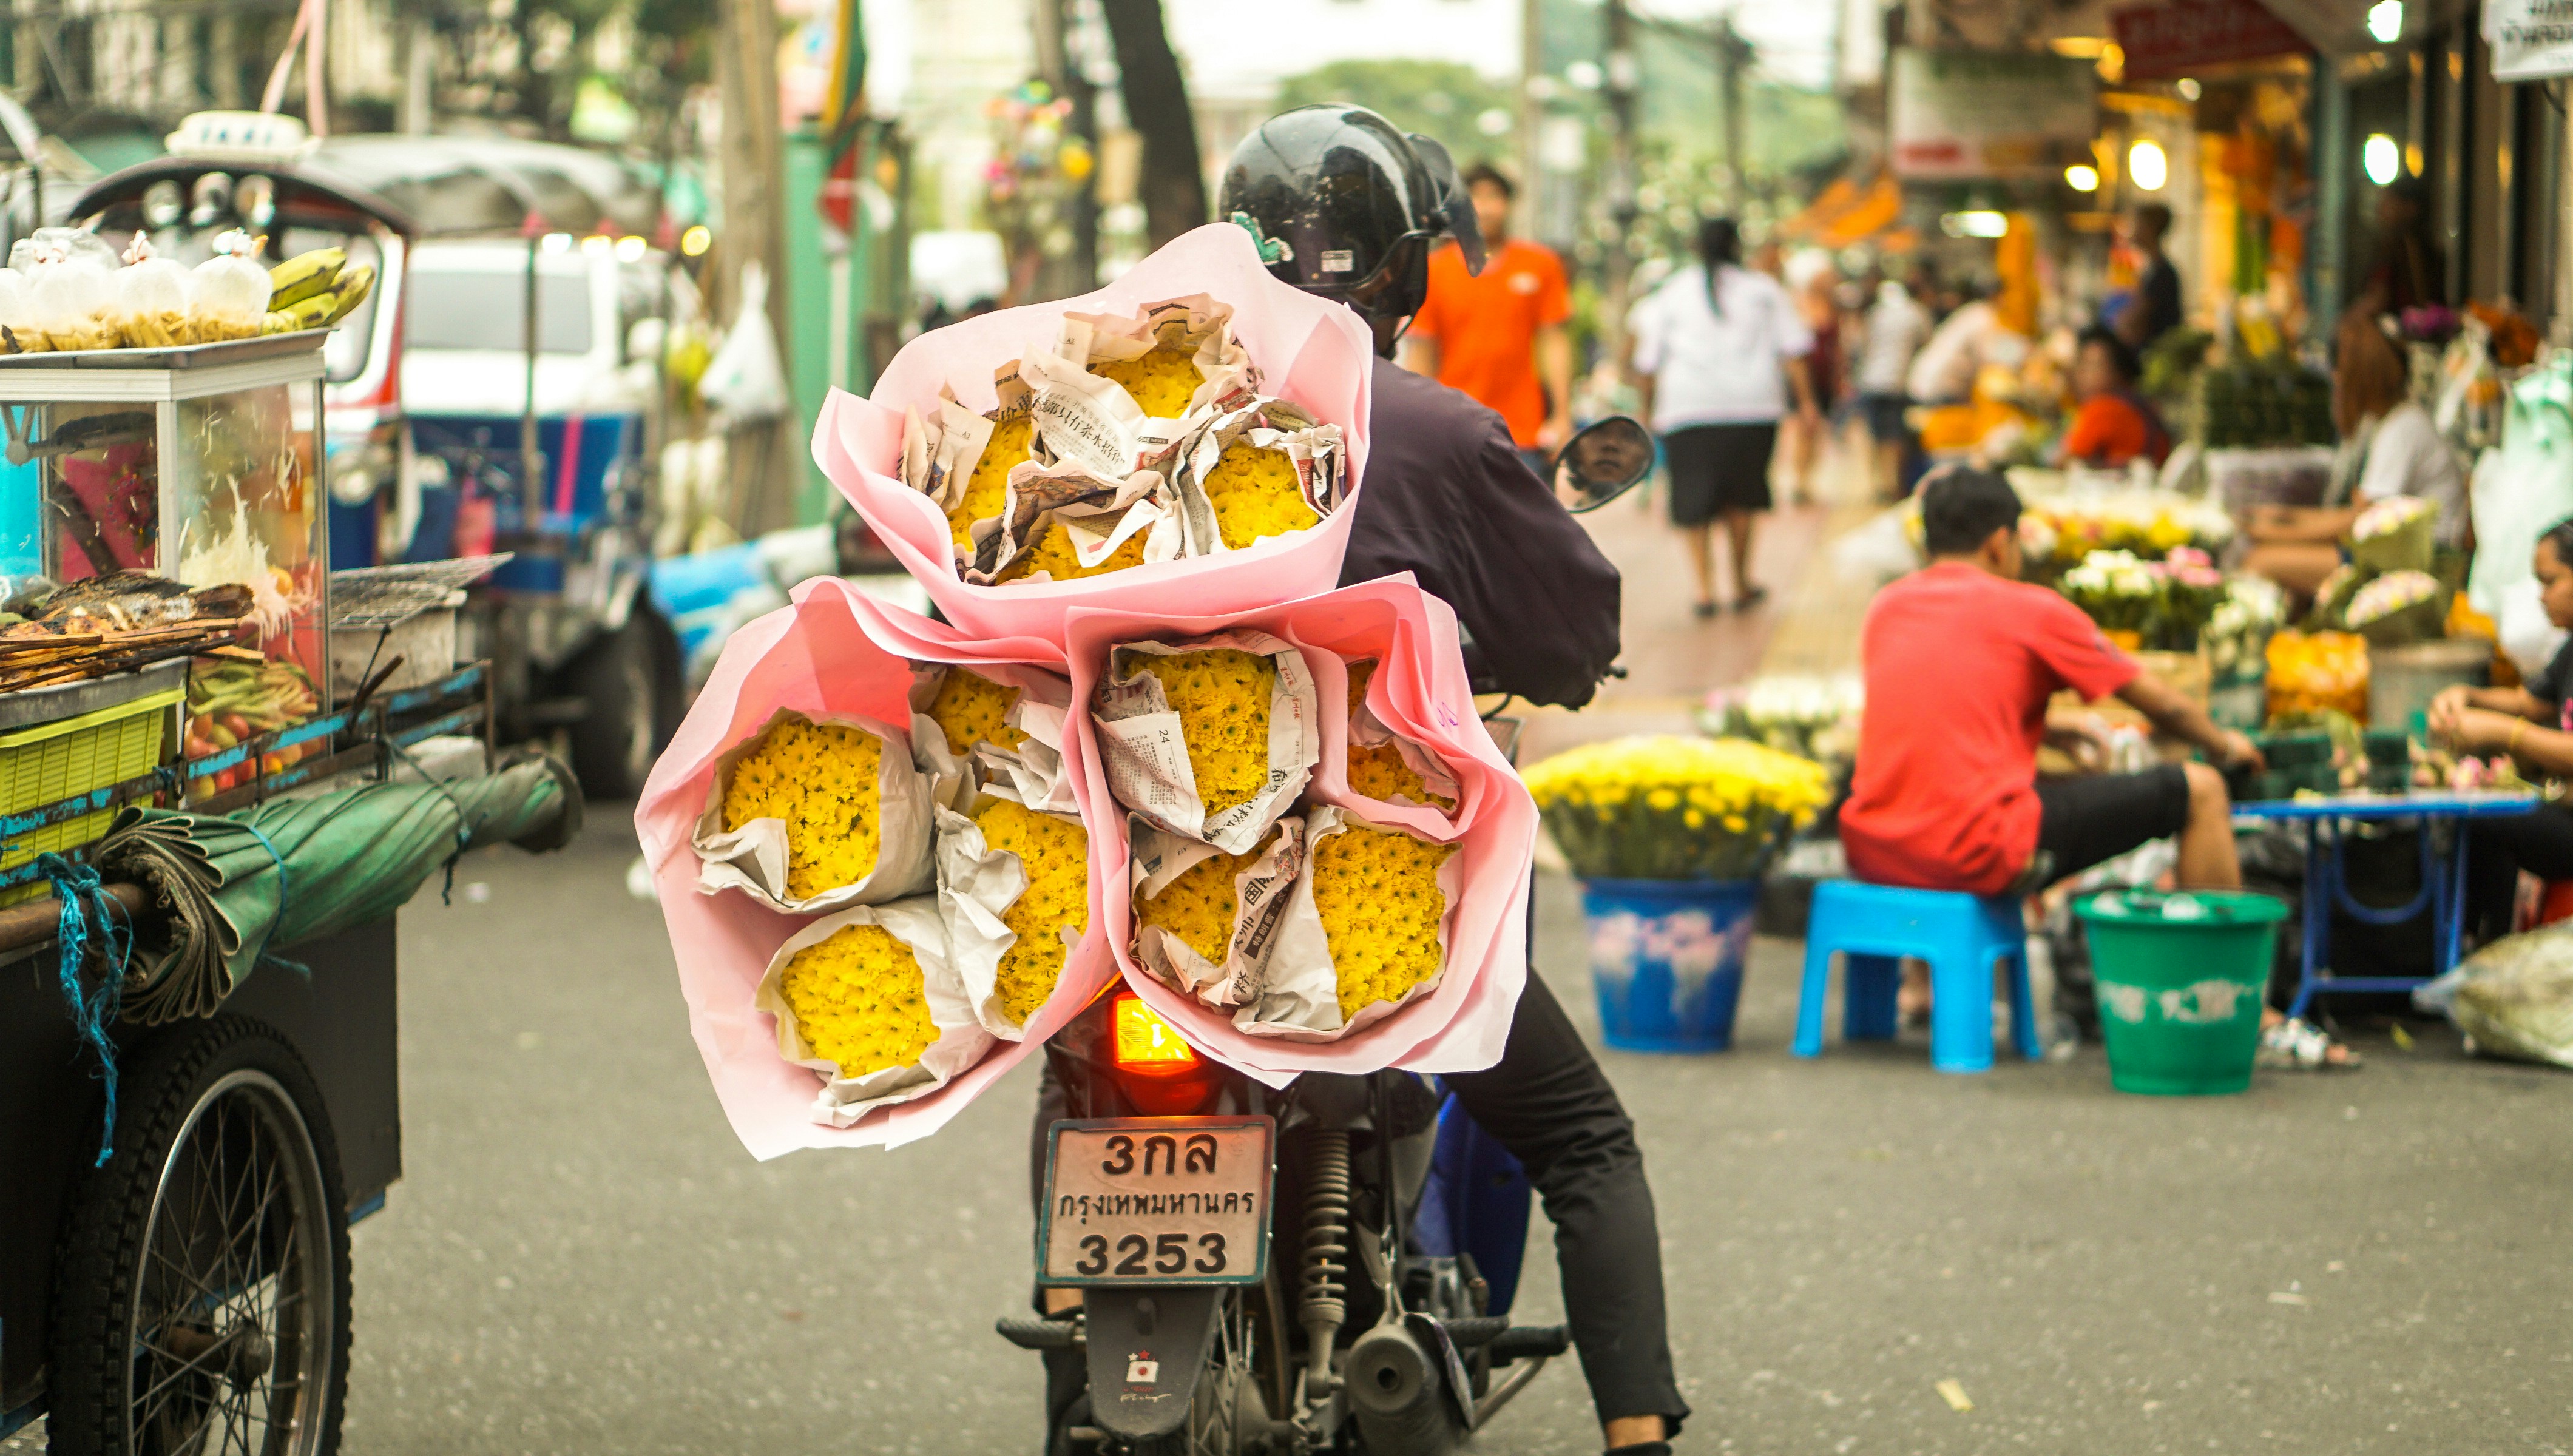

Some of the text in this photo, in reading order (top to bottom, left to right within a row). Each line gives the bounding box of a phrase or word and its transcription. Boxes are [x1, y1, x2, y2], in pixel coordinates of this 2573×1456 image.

[1158, 729, 1171, 744] 24
[1102, 1133, 1217, 1175] 3กล
[1060, 1191, 1255, 1224] กรุงเทพมหานคร
[1076, 1233, 1227, 1275] 3253
